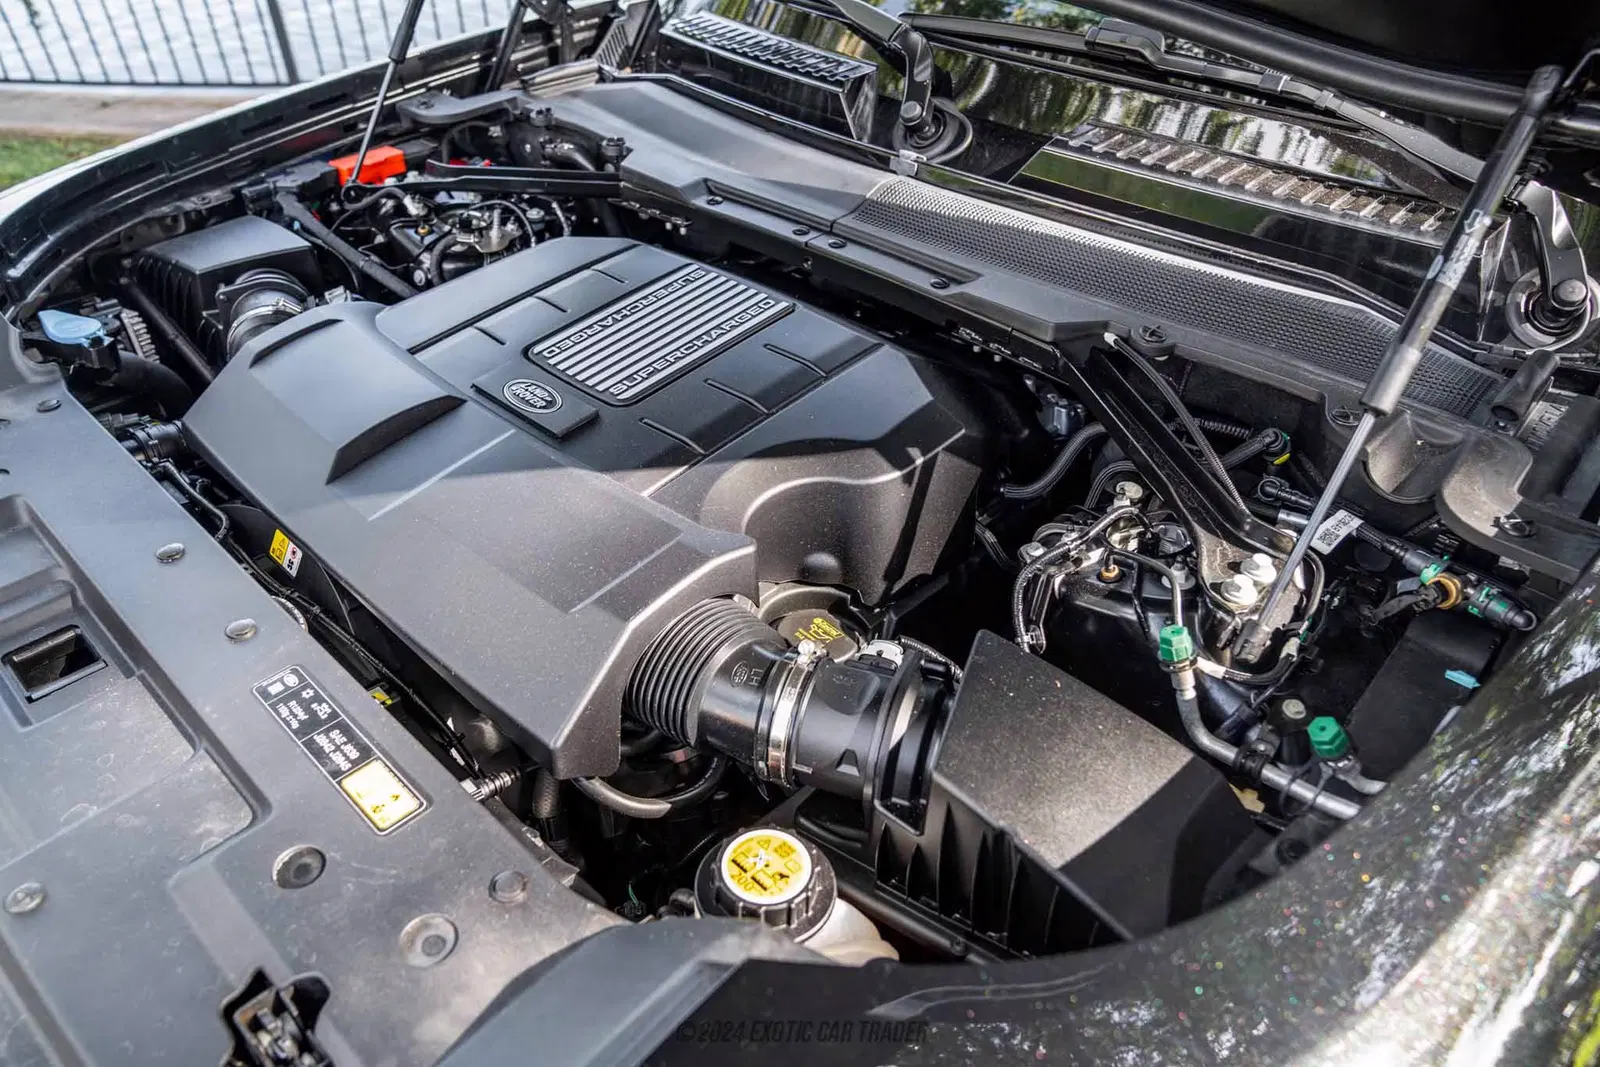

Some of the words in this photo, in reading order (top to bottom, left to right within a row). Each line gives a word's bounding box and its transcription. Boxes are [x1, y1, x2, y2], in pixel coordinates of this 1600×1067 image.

[543, 269, 707, 358] SUPERCHARGED
[609, 299, 776, 395] SUPERCHARGED
[513, 388, 547, 408] ROVER
[519, 382, 549, 399] LAND
[329, 729, 347, 745] SAE
